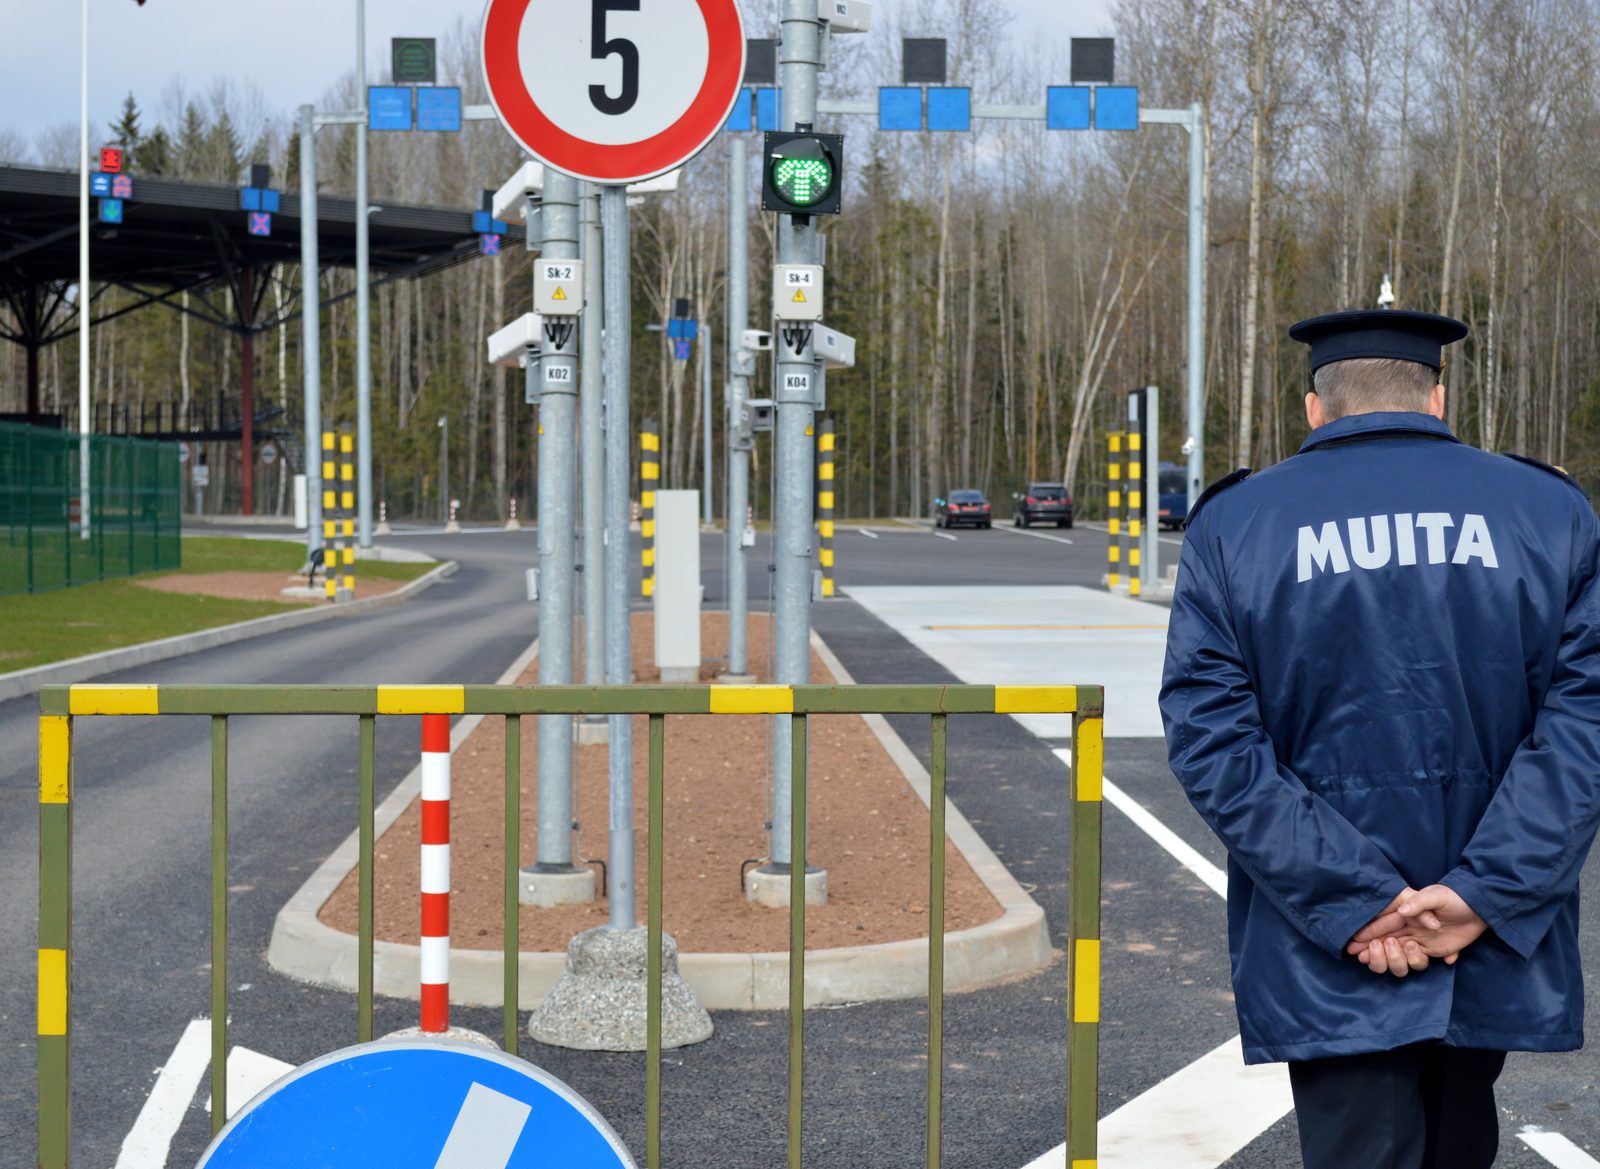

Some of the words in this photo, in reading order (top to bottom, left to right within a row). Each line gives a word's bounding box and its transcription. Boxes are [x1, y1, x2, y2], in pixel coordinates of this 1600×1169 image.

[588, 0, 640, 116] 5
[547, 267, 571, 279] Sk-2
[789, 273, 809, 283] Sk-4
[1297, 512, 1499, 583] MUITA
